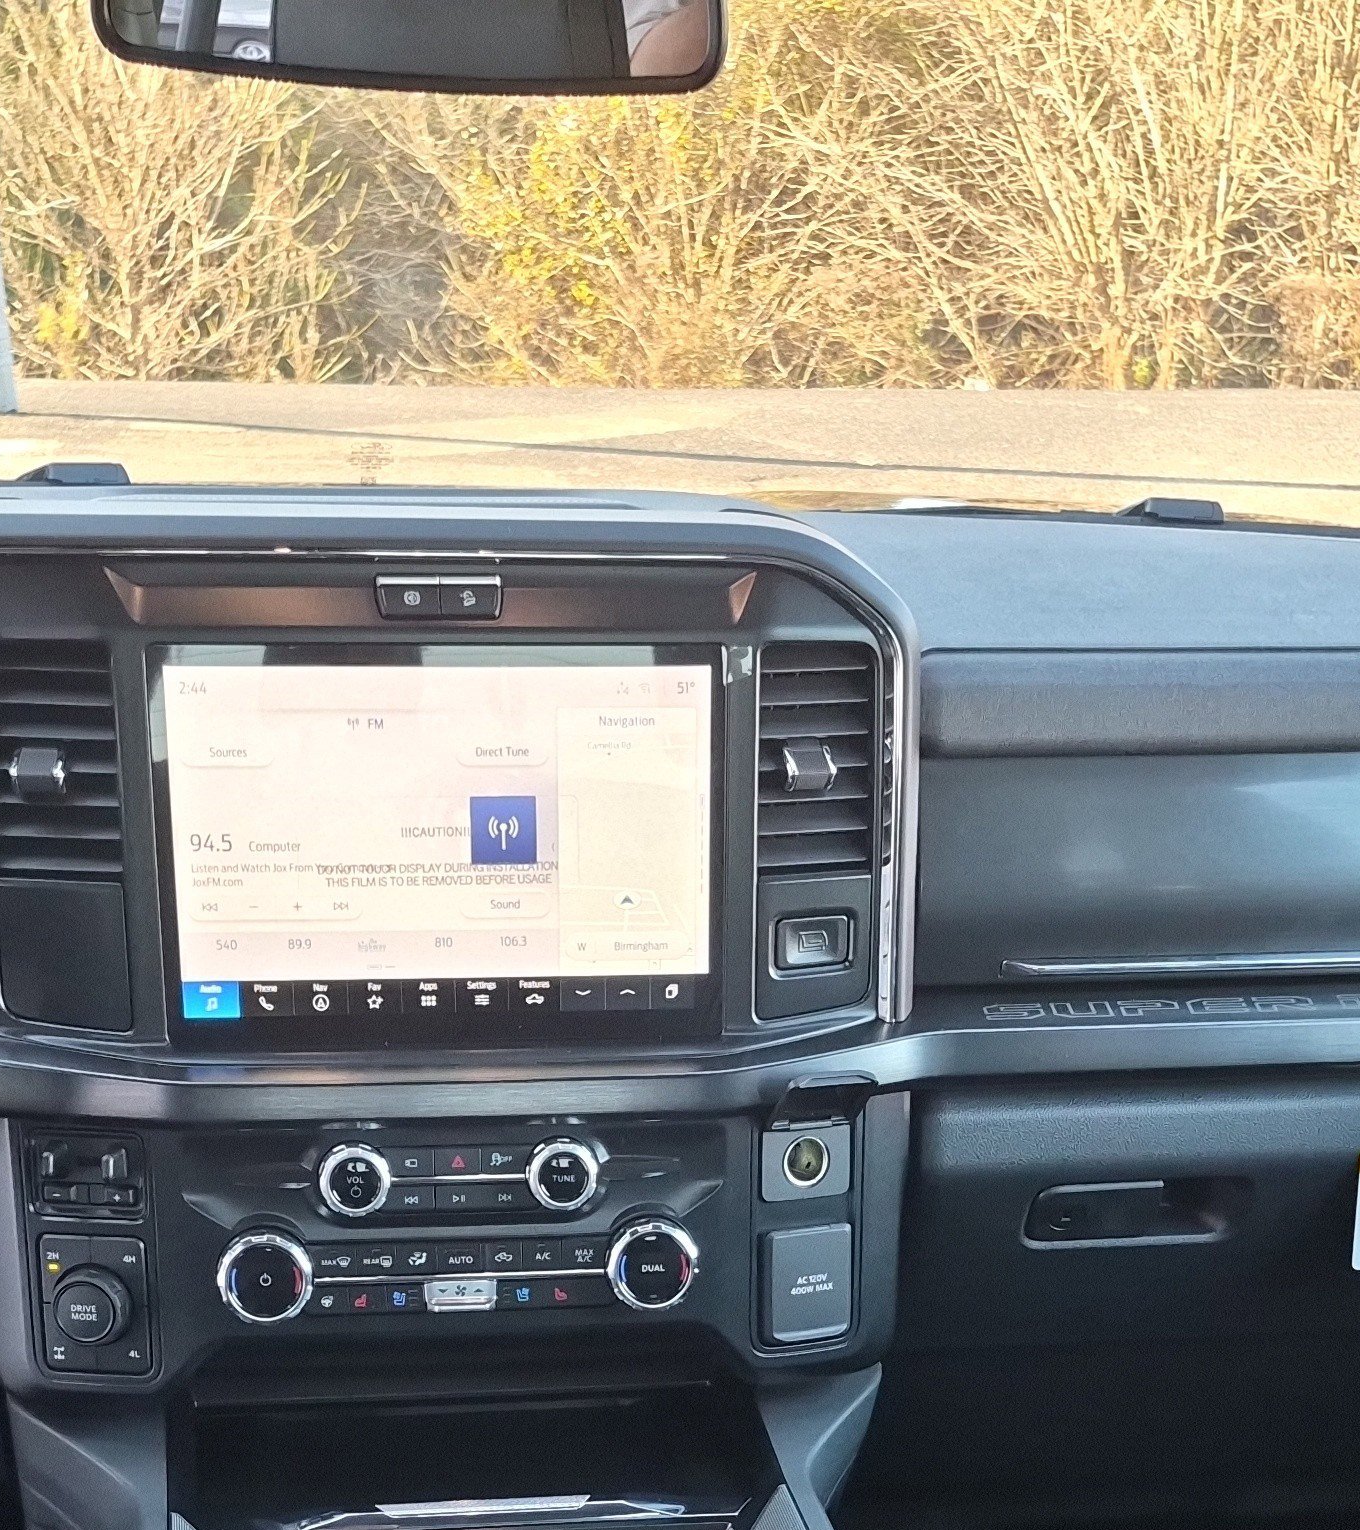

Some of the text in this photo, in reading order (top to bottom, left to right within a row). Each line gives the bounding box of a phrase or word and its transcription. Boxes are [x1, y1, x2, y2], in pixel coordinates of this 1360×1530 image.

[179, 681, 207, 695] 2:44
[677, 681, 696, 695] 51°
[367, 718, 384, 730] FM
[599, 715, 655, 728] Navigation
[209, 746, 248, 759] Sources
[475, 746, 530, 758] Direct Tune
[190, 833, 233, 853] 94.5
[248, 840, 301, 854] Computer
[191, 863, 220, 874] Listen
[221, 863, 239, 874] and
[240, 863, 271, 873] Watch
[272, 863, 287, 873] Jox
[289, 863, 314, 873] From
[399, 863, 442, 874] DISPLAY
[444, 862, 485, 873] DURING
[486, 861, 559, 872] INSTALLATION
[192, 877, 244, 888] JoxFM.com
[325, 873, 553, 888] THIS FILM IS TO BE REMOVED BEFORE USAGE
[490, 899, 521, 910] Sound
[216, 939, 238, 951] 540
[288, 938, 312, 950] 89.9
[435, 936, 453, 948] 810
[500, 935, 527, 947] 106.3
[577, 942, 587, 952] W
[614, 941, 669, 953] Birmingham
[199, 984, 222, 994] Audio
[253, 983, 278, 993] Phone
[312, 983, 328, 992] Nav
[367, 981, 382, 991] Fav
[419, 981, 438, 992] Apps
[467, 980, 497, 990] Settings
[519, 979, 551, 989] Features
[982, 994, 1317, 1020] SUPER
[346, 1176, 364, 1184] VOL
[552, 1174, 576, 1183] TUNE
[46, 1251, 60, 1260] 2H
[122, 1255, 136, 1263] 4H
[448, 1255, 474, 1264] AUTO
[535, 1252, 551, 1260] A/C
[577, 1255, 592, 1263] A/C
[641, 1264, 665, 1272] DUAL
[796, 1273, 828, 1285] AC 120V
[790, 1281, 833, 1295] 400W MAX
[70, 1304, 97, 1313] DRIVE
[71, 1313, 98, 1321] MODE
[128, 1350, 141, 1358] 4L
